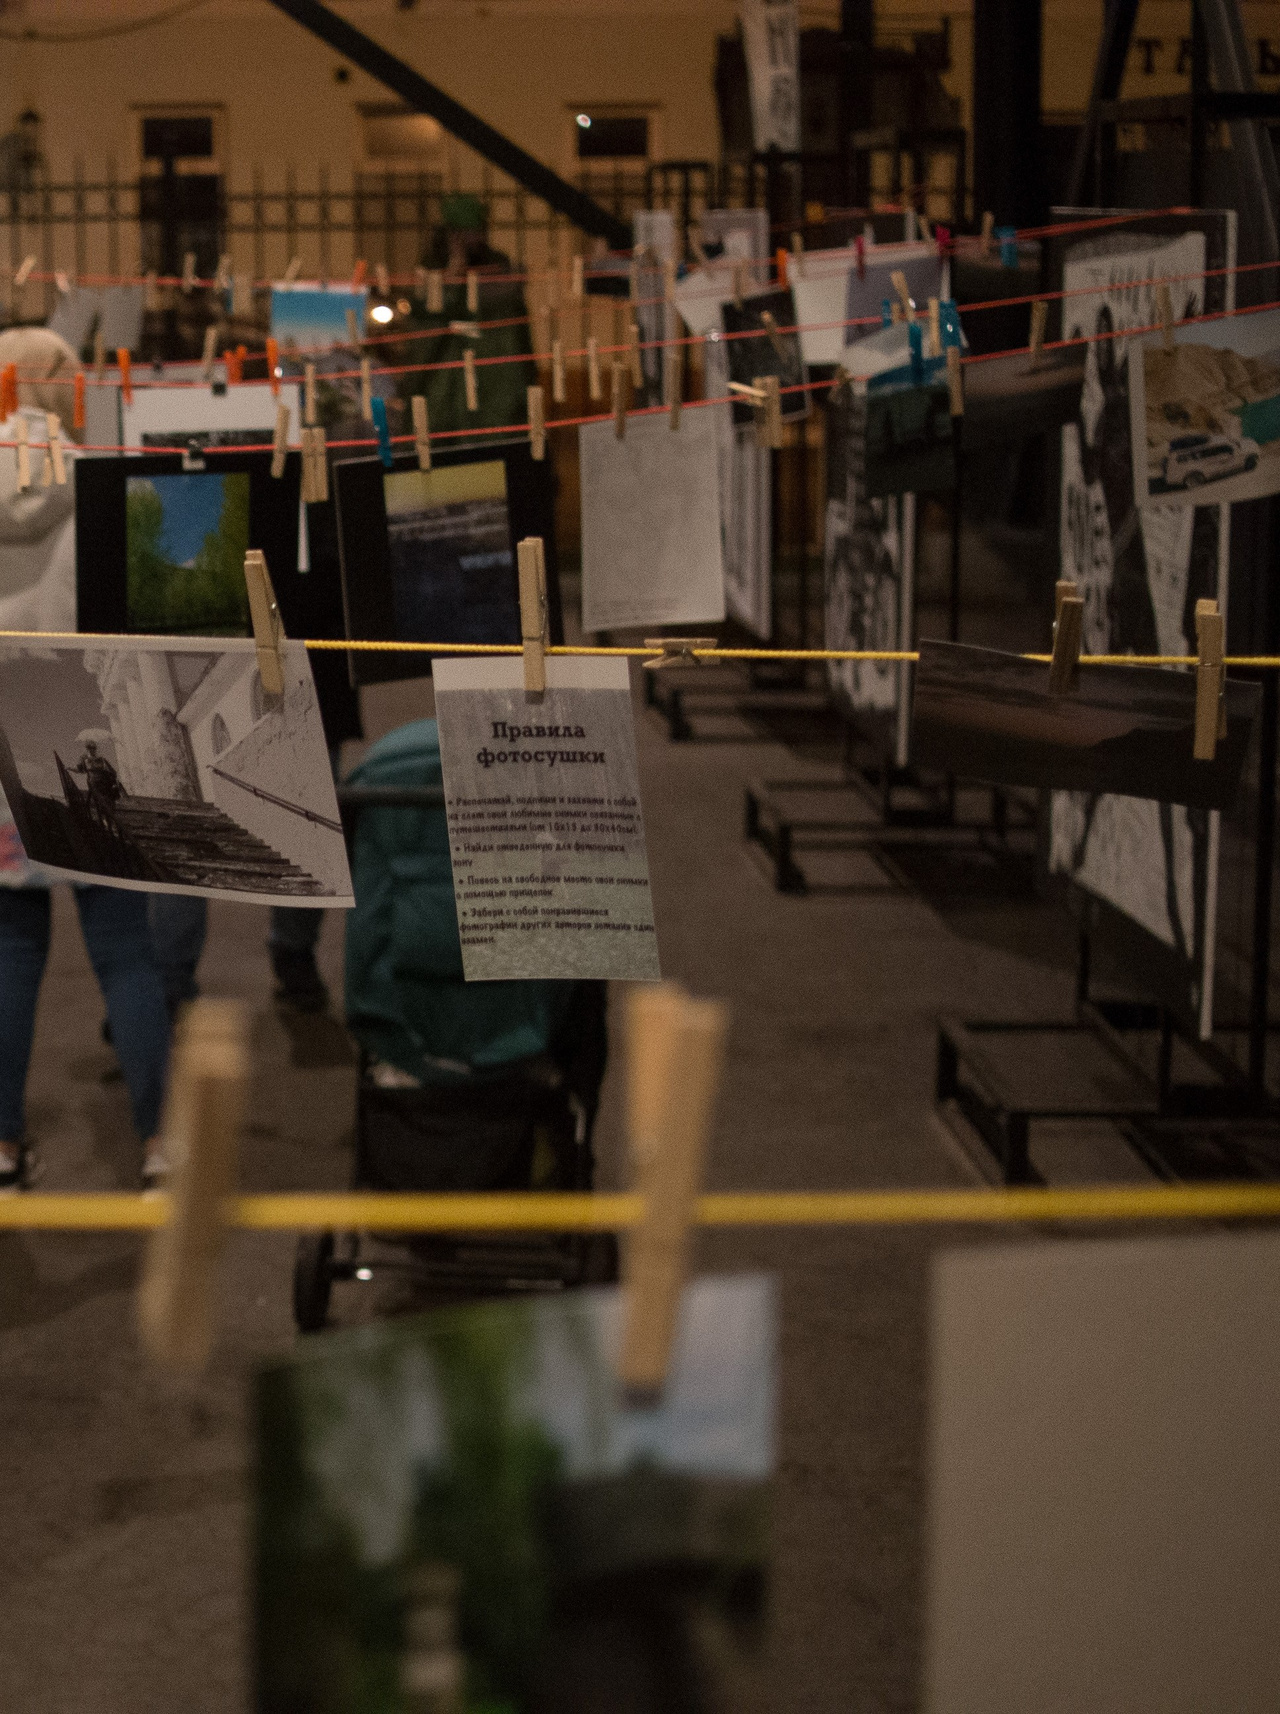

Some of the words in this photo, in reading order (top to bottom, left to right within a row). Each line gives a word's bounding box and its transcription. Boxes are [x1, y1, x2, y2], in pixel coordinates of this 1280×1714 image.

[492, 721, 585, 742] Правила
[477, 747, 605, 768] фотосушки
[464, 843, 493, 852] Найди
[556, 843, 571, 851] для
[513, 907, 538, 916] собой
